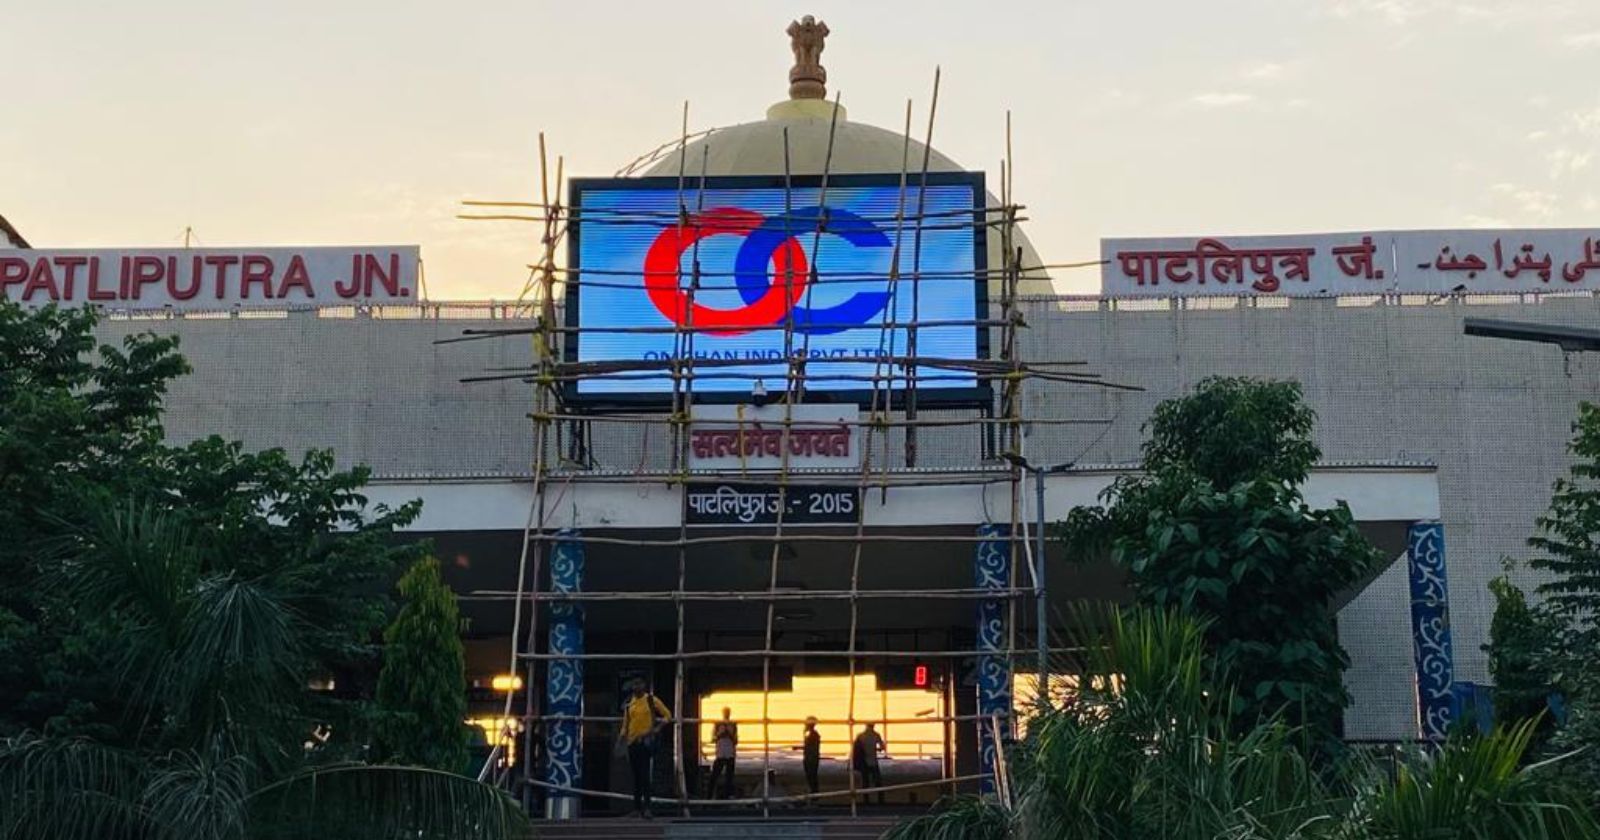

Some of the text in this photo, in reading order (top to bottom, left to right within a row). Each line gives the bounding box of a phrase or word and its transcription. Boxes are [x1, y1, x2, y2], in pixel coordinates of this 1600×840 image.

[0, 253, 410, 301] PATLIPUTRA JN.
[1117, 238, 1316, 293] पाटलिपुत्र
[688, 485, 766, 522] पाटलिपुत्र
[809, 492, 854, 514] 2015
